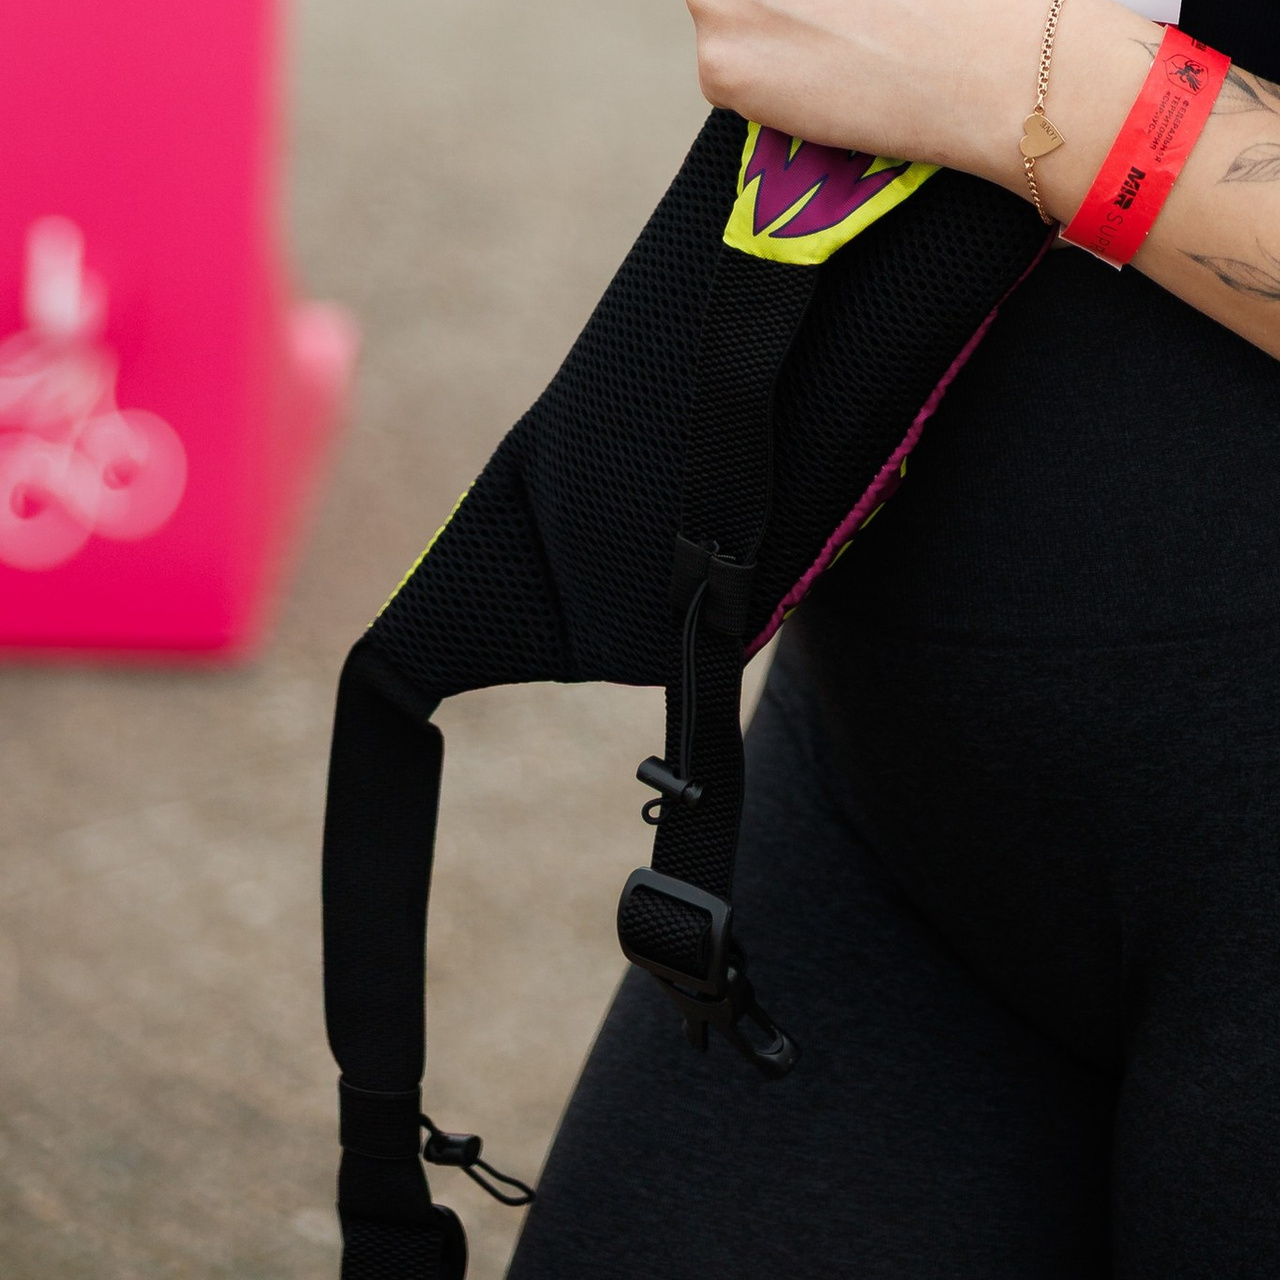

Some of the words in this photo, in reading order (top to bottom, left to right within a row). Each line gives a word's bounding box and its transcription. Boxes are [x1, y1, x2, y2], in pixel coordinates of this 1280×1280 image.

[1040, 120, 1058, 141] LOVE
[1149, 95, 1181, 150] ТЕРРИТОРИЯ
[1155, 100, 1190, 163] ФЕДЕРАЛЬНАЯ
[1113, 166, 1146, 210] MIR
